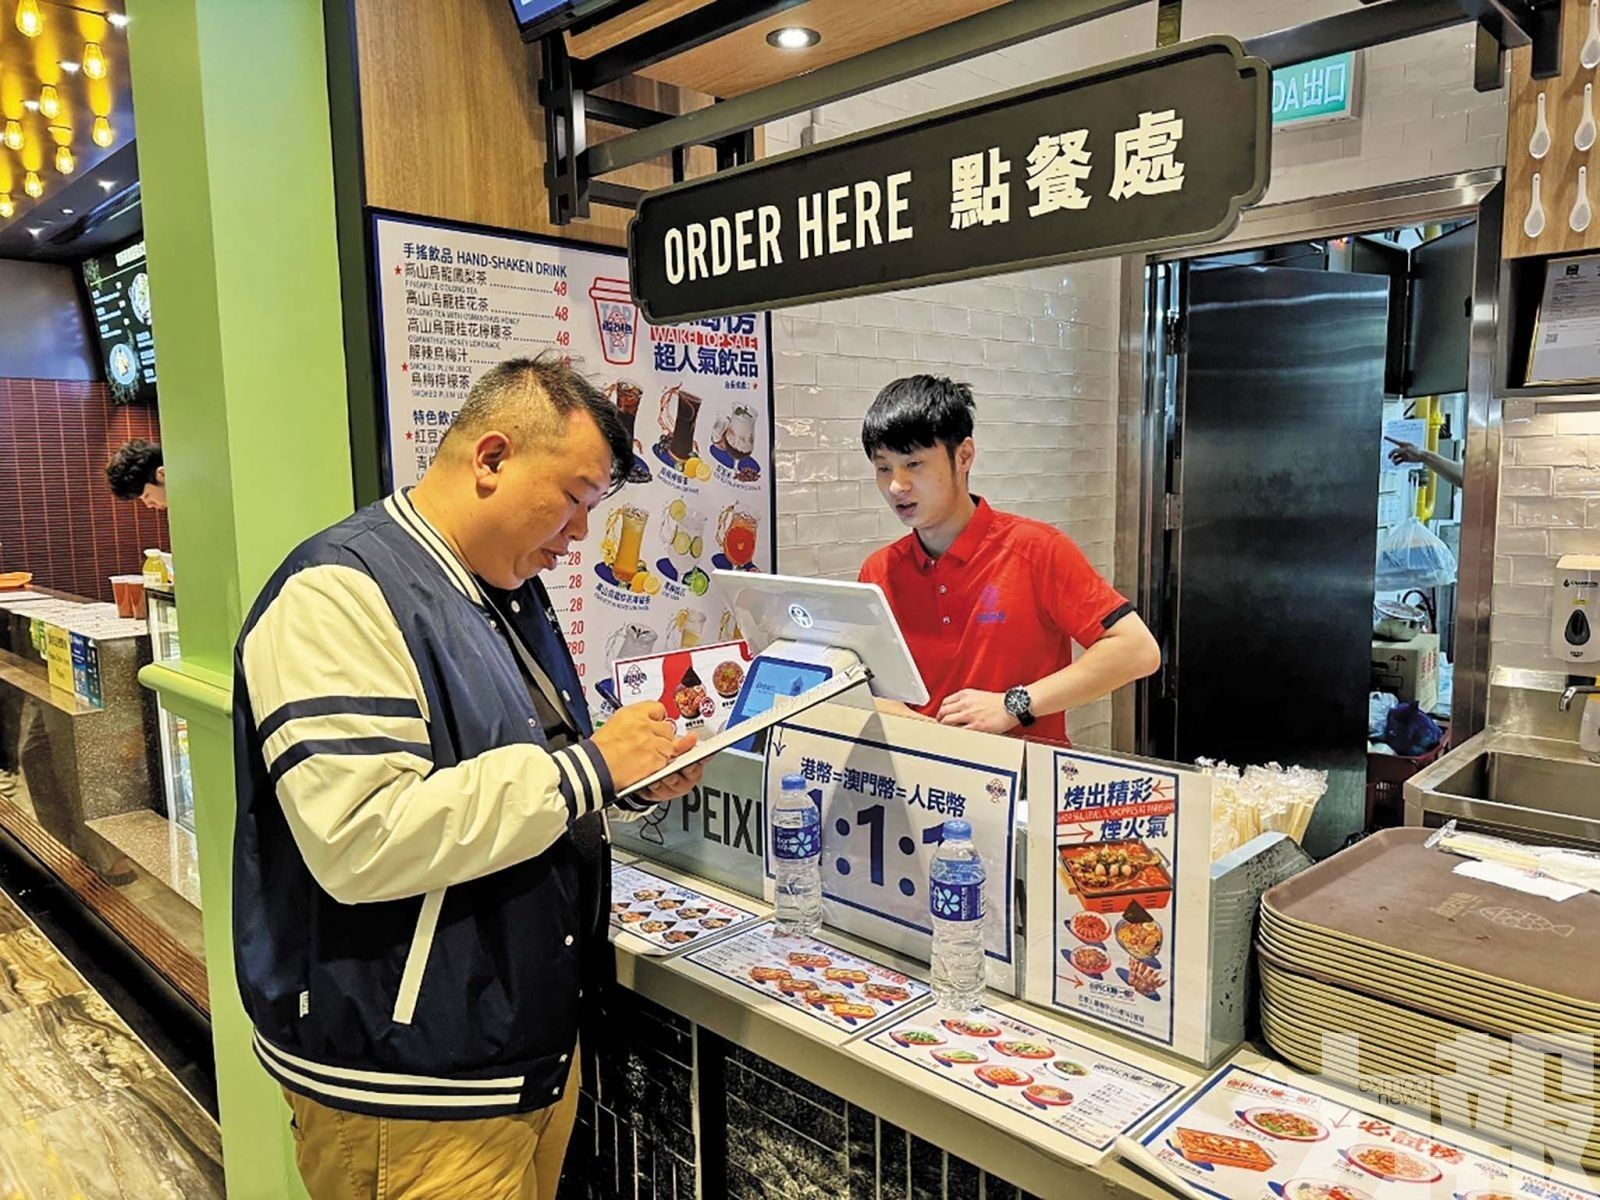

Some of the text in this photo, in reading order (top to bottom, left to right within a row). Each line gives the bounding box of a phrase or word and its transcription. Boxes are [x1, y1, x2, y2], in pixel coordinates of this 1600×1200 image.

[1303, 63, 1346, 108] 出口
[664, 108, 1185, 285] ORDER HERE 點餐處
[457, 251, 533, 273] HAND-SHAKEN
[536, 263, 567, 278] DRINK
[553, 281, 567, 296] 48
[554, 306, 568, 321] 48
[556, 331, 570, 346] 48
[727, 333, 758, 350] SALE
[654, 342, 758, 377] 超人氣飲品
[415, 428, 447, 443] 紅豆
[568, 552, 581, 565] 28
[569, 574, 582, 589] 28
[570, 598, 583, 612] 28
[571, 620, 584, 635] 20
[1063, 777, 1153, 810] 烤出精彩
[1100, 815, 1168, 841] 煙火氣
